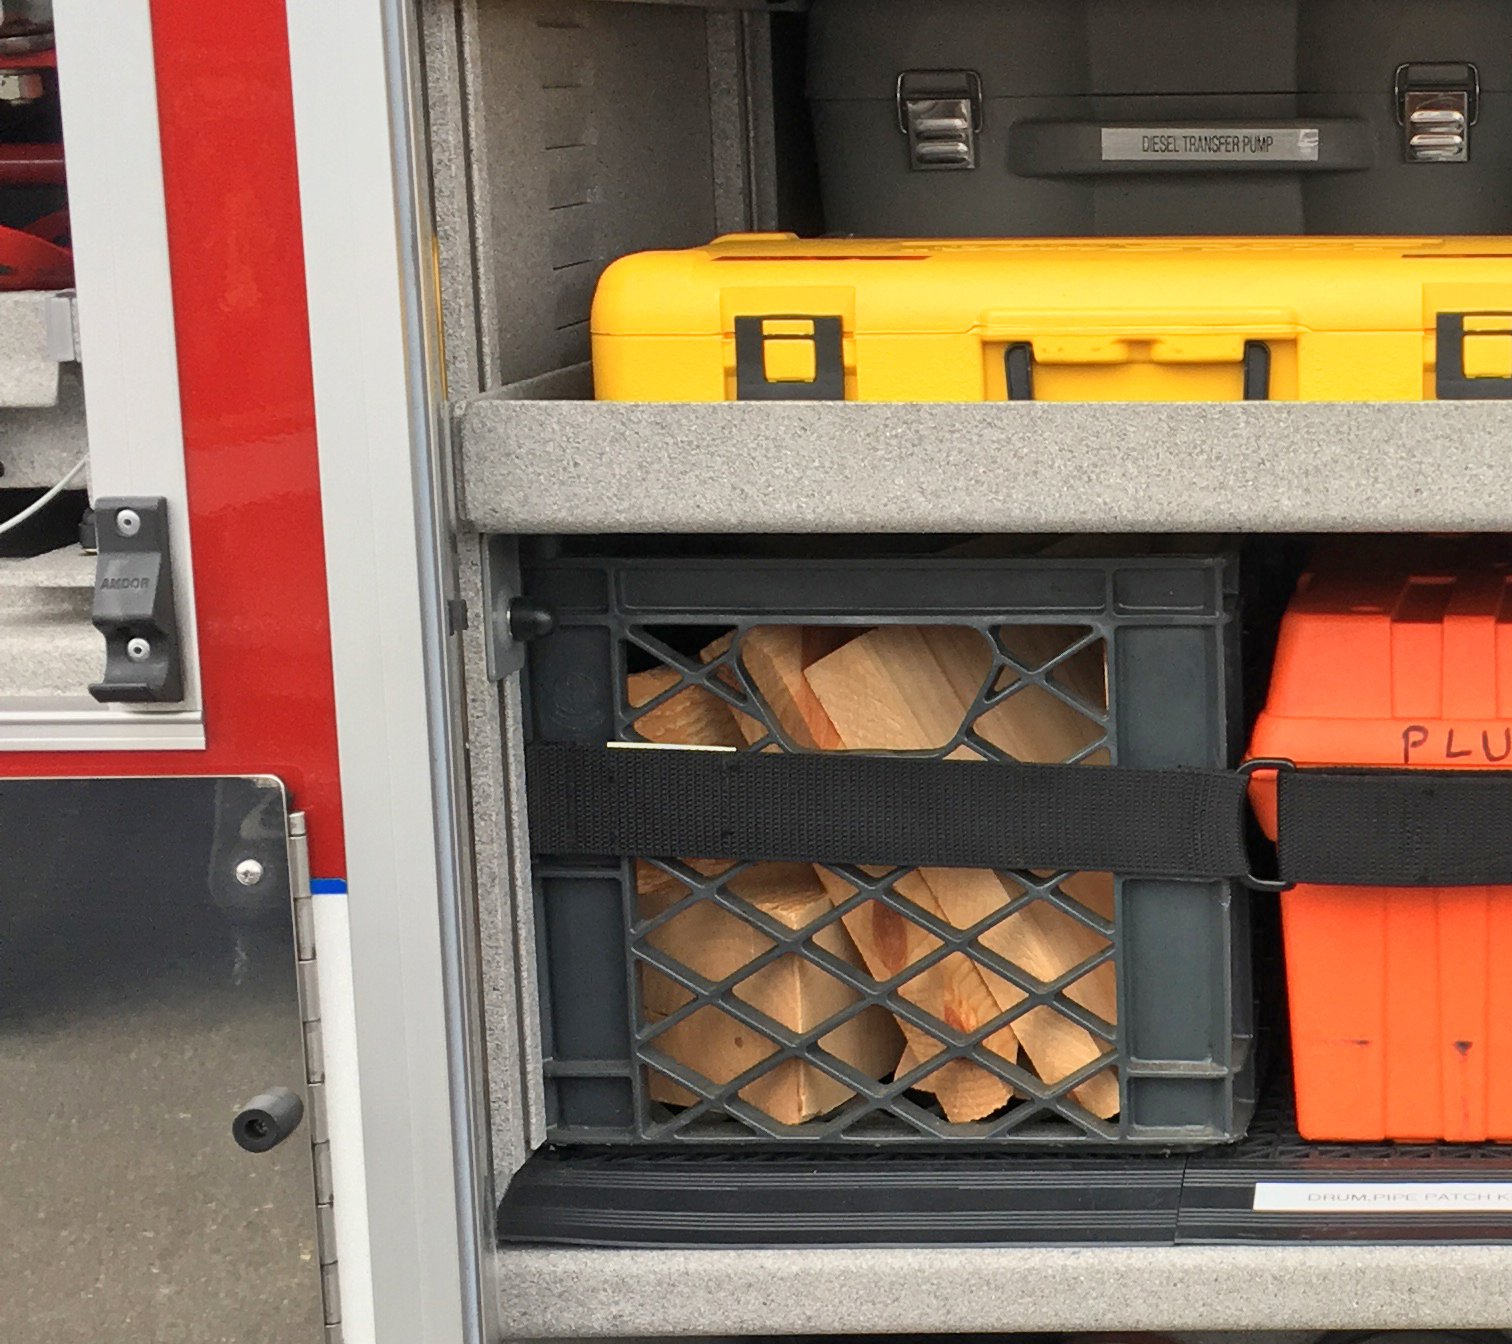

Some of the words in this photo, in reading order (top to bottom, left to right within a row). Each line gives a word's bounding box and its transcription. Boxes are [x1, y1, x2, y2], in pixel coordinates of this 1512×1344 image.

[1142, 135, 1180, 153] DIESEL
[1182, 135, 1240, 153] TRANSFER
[1242, 135, 1273, 153] PUMP
[100, 576, 151, 590] AMDOR
[1425, 1192, 1491, 1202] PATCH
